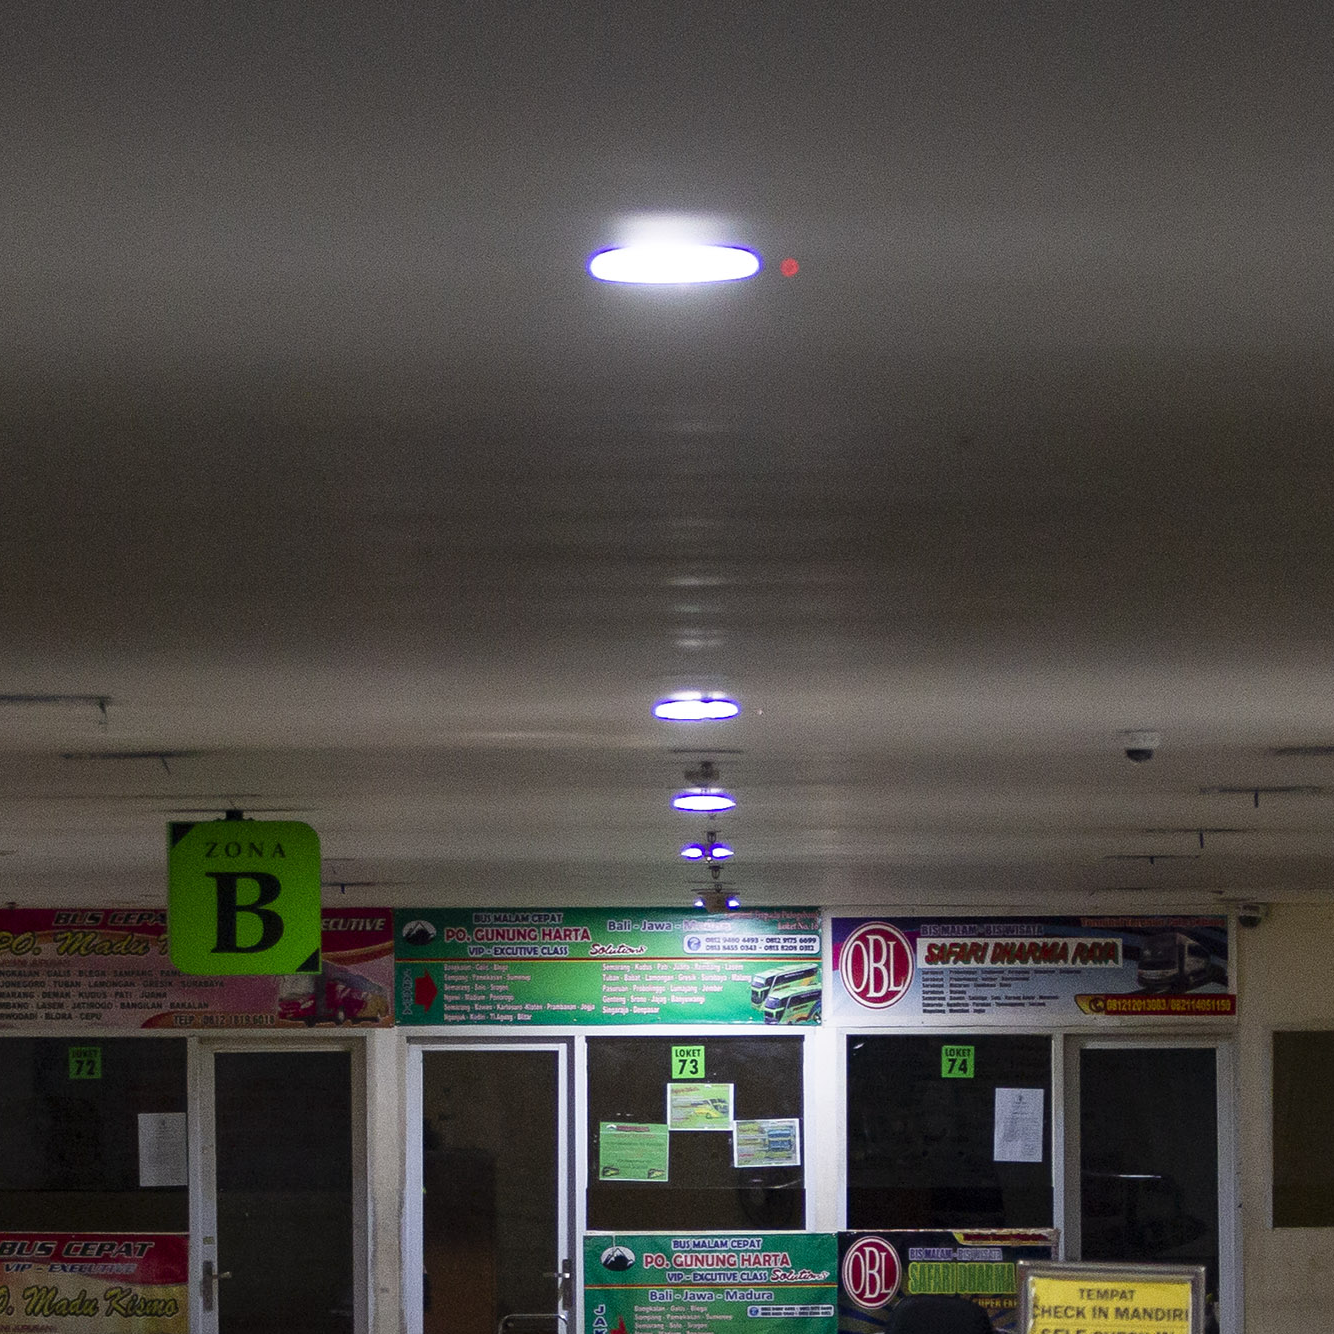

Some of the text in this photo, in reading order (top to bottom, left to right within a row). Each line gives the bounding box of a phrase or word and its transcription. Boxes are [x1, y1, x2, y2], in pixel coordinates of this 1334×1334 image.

[206, 841, 286, 858] ZONA
[52, 911, 167, 927] BUS CEPA
[206, 871, 284, 954] B
[474, 913, 563, 923] BUS MALAM CEPAT
[322, 917, 386, 932] ECUTIVE
[608, 920, 672, 931] Bali Jawa
[445, 928, 591, 942] PO. GUNUNG HARTA
[53, 930, 151, 957] Madu
[469, 947, 485, 956] VIP
[540, 947, 569, 956] CLASS
[925, 941, 1118, 965] SAFARI DHARMA RAYA
[847, 934, 907, 998] OBL
[675, 1048, 701, 1058] LOKET
[76, 1060, 96, 1075] 72
[678, 1059, 699, 1075] 73
[948, 1058, 968, 1074] 74
[62, 1241, 155, 1257] CEPAT
[673, 1239, 762, 1250] BUS MALAM CEPAT
[4, 1263, 32, 1273] VIP
[644, 1253, 791, 1269] PO. GUNUNG HARTA
[667, 1272, 767, 1283] VIP EXCUTIVE CLASS
[851, 1245, 894, 1300] OBL
[909, 1262, 1016, 1294] SAFARI DHARMA
[22, 1285, 99, 1317] Madu
[649, 1290, 775, 1303] Bali Jawa Madura
[1078, 1288, 1136, 1301] TEMPAT
[1033, 1304, 1189, 1322] CHECK IN MANDIRI
